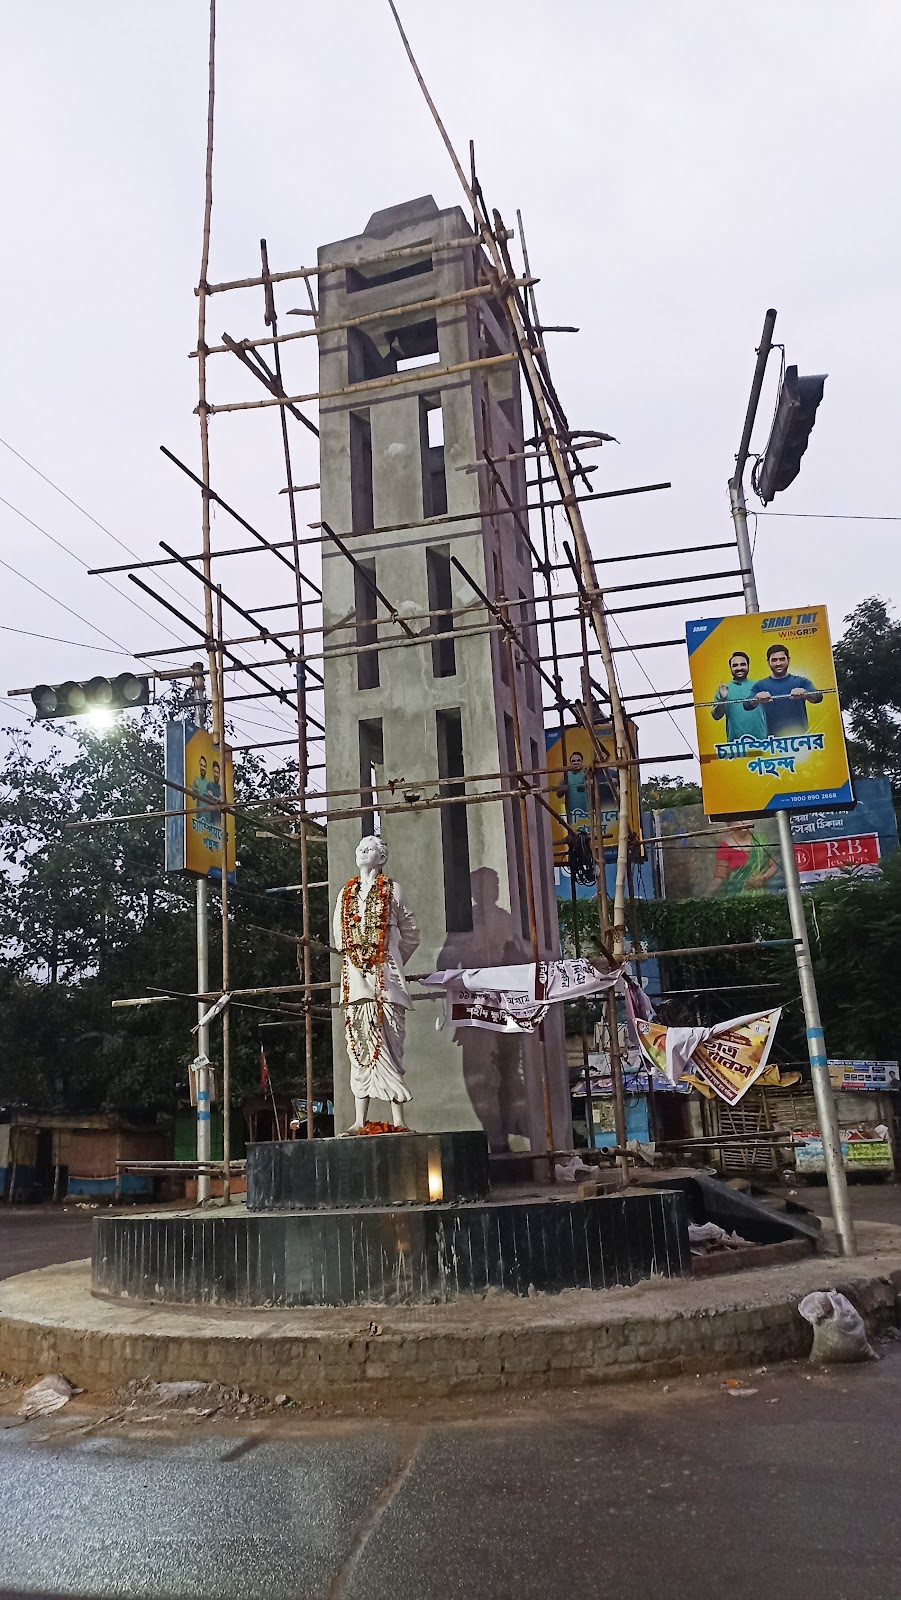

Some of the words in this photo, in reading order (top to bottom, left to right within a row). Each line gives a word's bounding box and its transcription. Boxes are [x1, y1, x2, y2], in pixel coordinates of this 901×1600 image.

[761, 614, 793, 629] SRMB
[796, 612, 819, 625] TMT
[778, 627, 818, 638] WINGRIP
[714, 733, 825, 760] চ্যাম্পিয়নের
[747, 756, 796, 779] পছন্দ
[816, 818, 844, 830] ঠিকানা
[825, 839, 869, 857] R.B.
[826, 855, 870, 868] Jewllers
